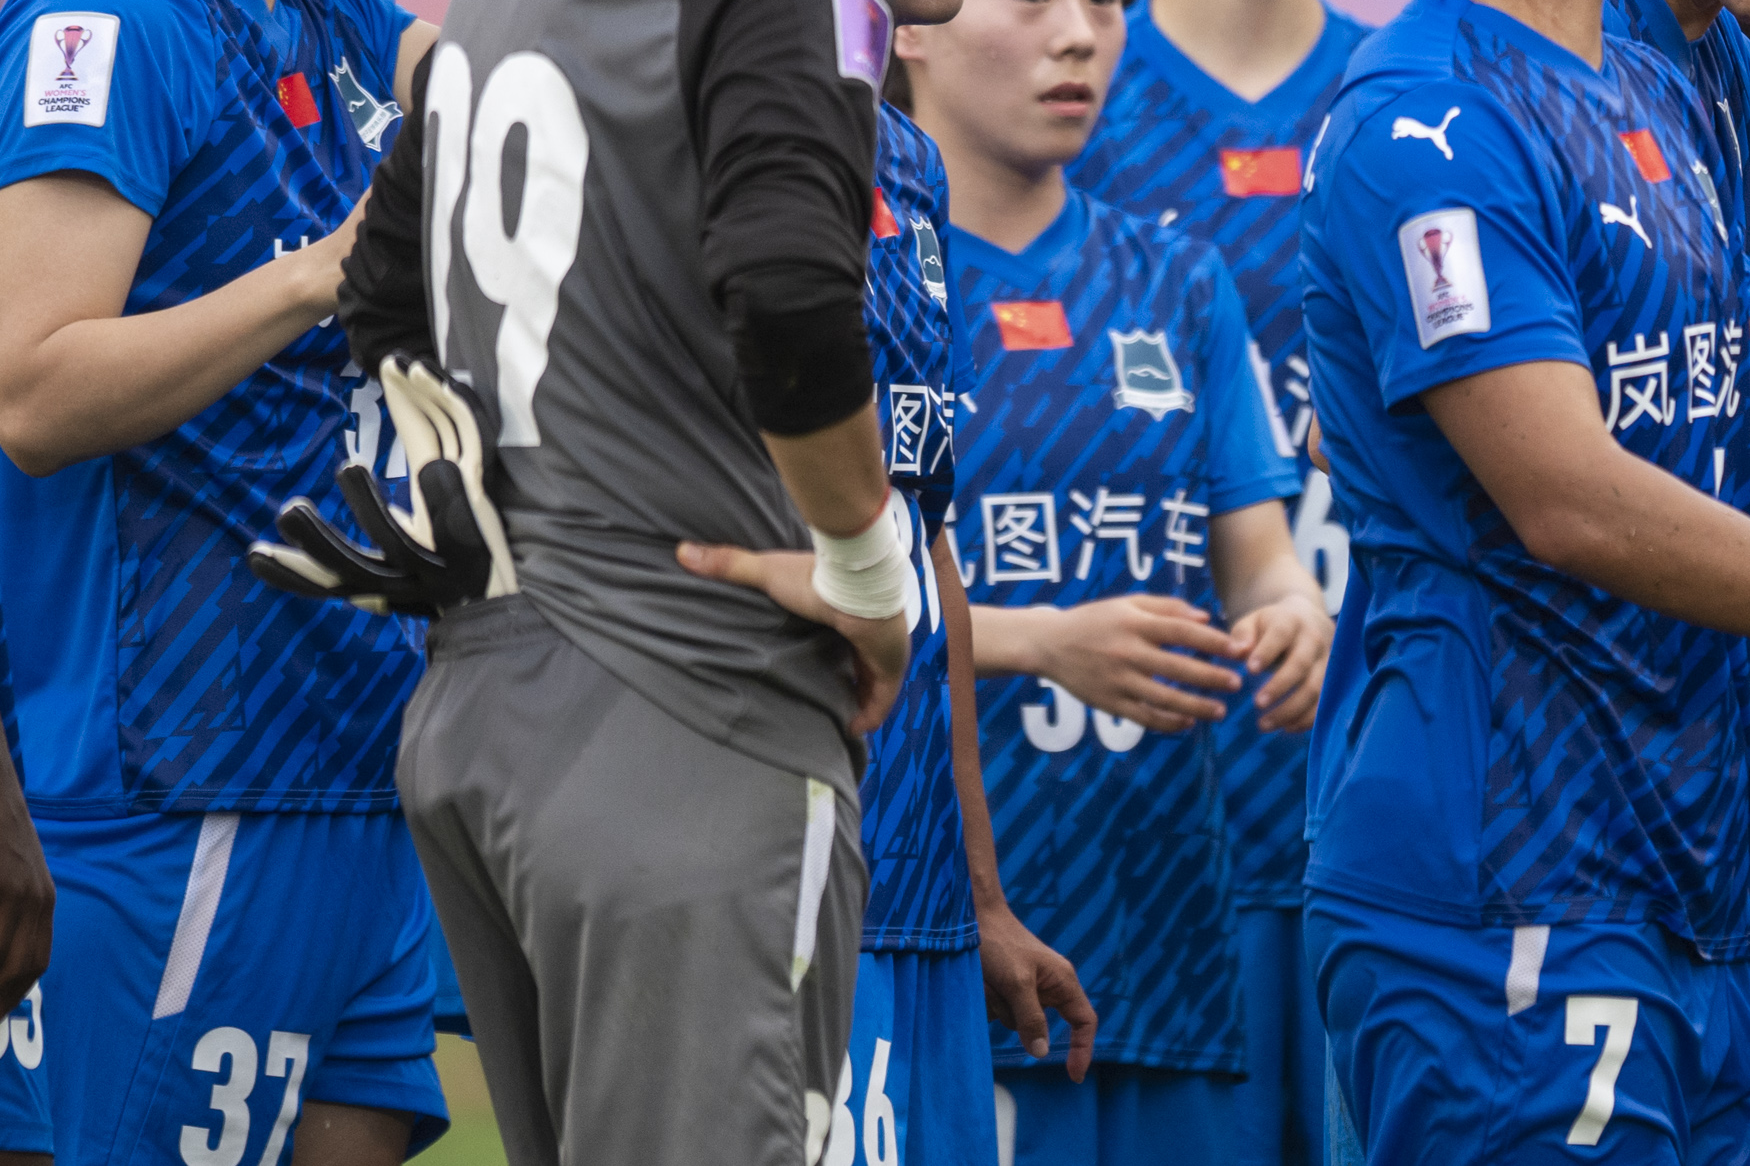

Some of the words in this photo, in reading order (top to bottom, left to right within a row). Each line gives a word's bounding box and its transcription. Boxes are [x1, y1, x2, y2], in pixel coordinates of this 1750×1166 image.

[38, 96, 91, 106] CHAMPIONS
[179, 1026, 312, 1166] 37
[1565, 996, 1639, 1147] 7
